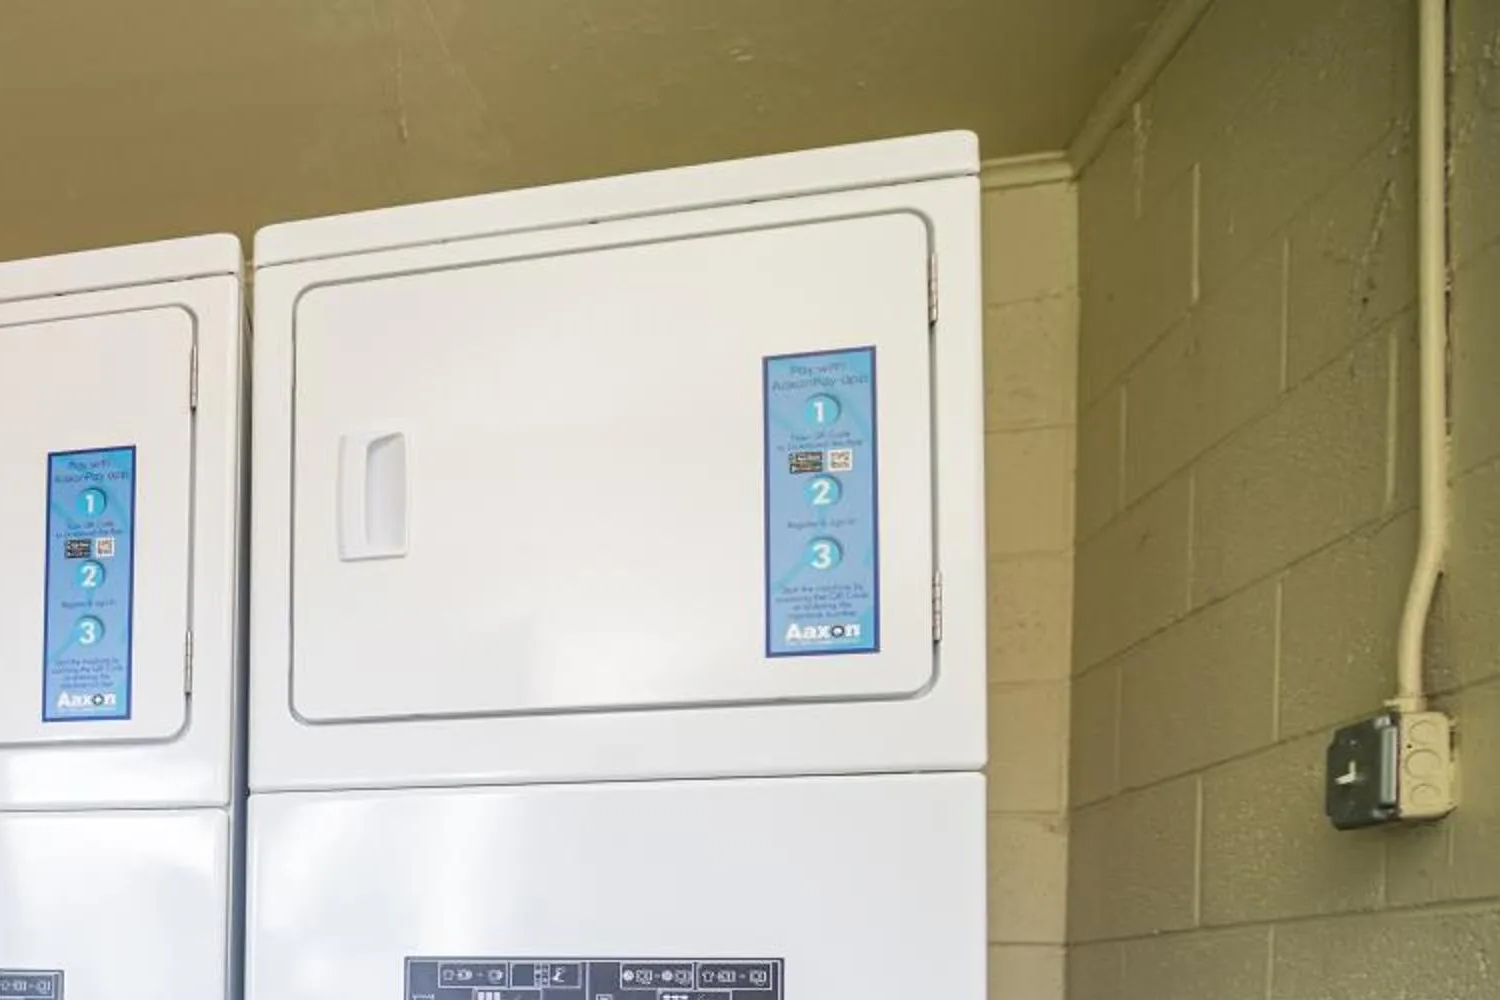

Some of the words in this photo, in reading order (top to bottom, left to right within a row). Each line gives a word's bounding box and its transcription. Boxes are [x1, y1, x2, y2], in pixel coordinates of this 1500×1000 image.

[813, 401, 825, 423] 1
[810, 480, 831, 505] 2
[85, 494, 95, 515] 1
[811, 543, 832, 570] 3
[82, 563, 97, 588] 2
[80, 621, 96, 645] 3
[786, 623, 861, 640] Aaxon
[58, 691, 117, 708] Aaxon
